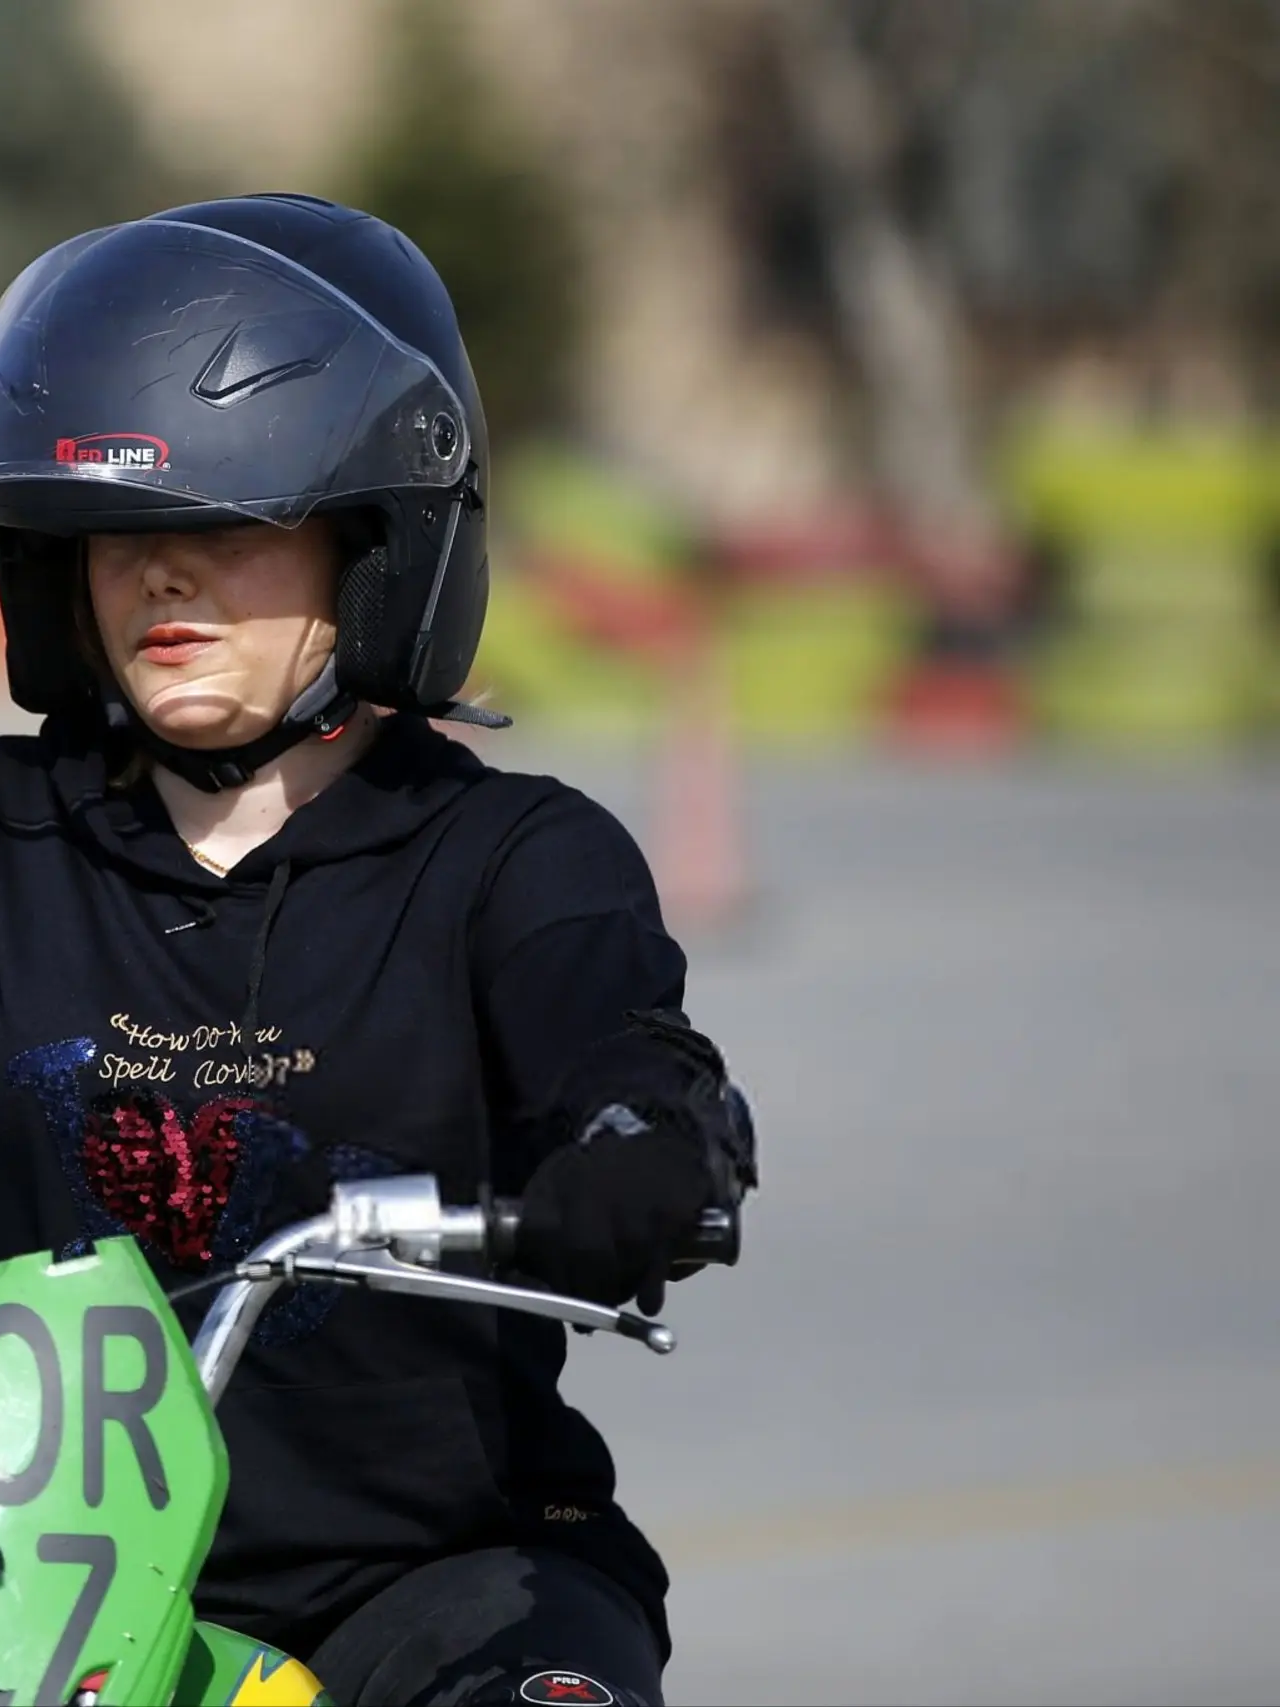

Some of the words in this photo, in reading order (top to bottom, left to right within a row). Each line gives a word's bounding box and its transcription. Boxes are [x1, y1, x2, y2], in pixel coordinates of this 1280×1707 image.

[108, 448, 155, 464] LINE
[98, 1053, 177, 1088] Spell
[552, 1676, 580, 1685] PRO
